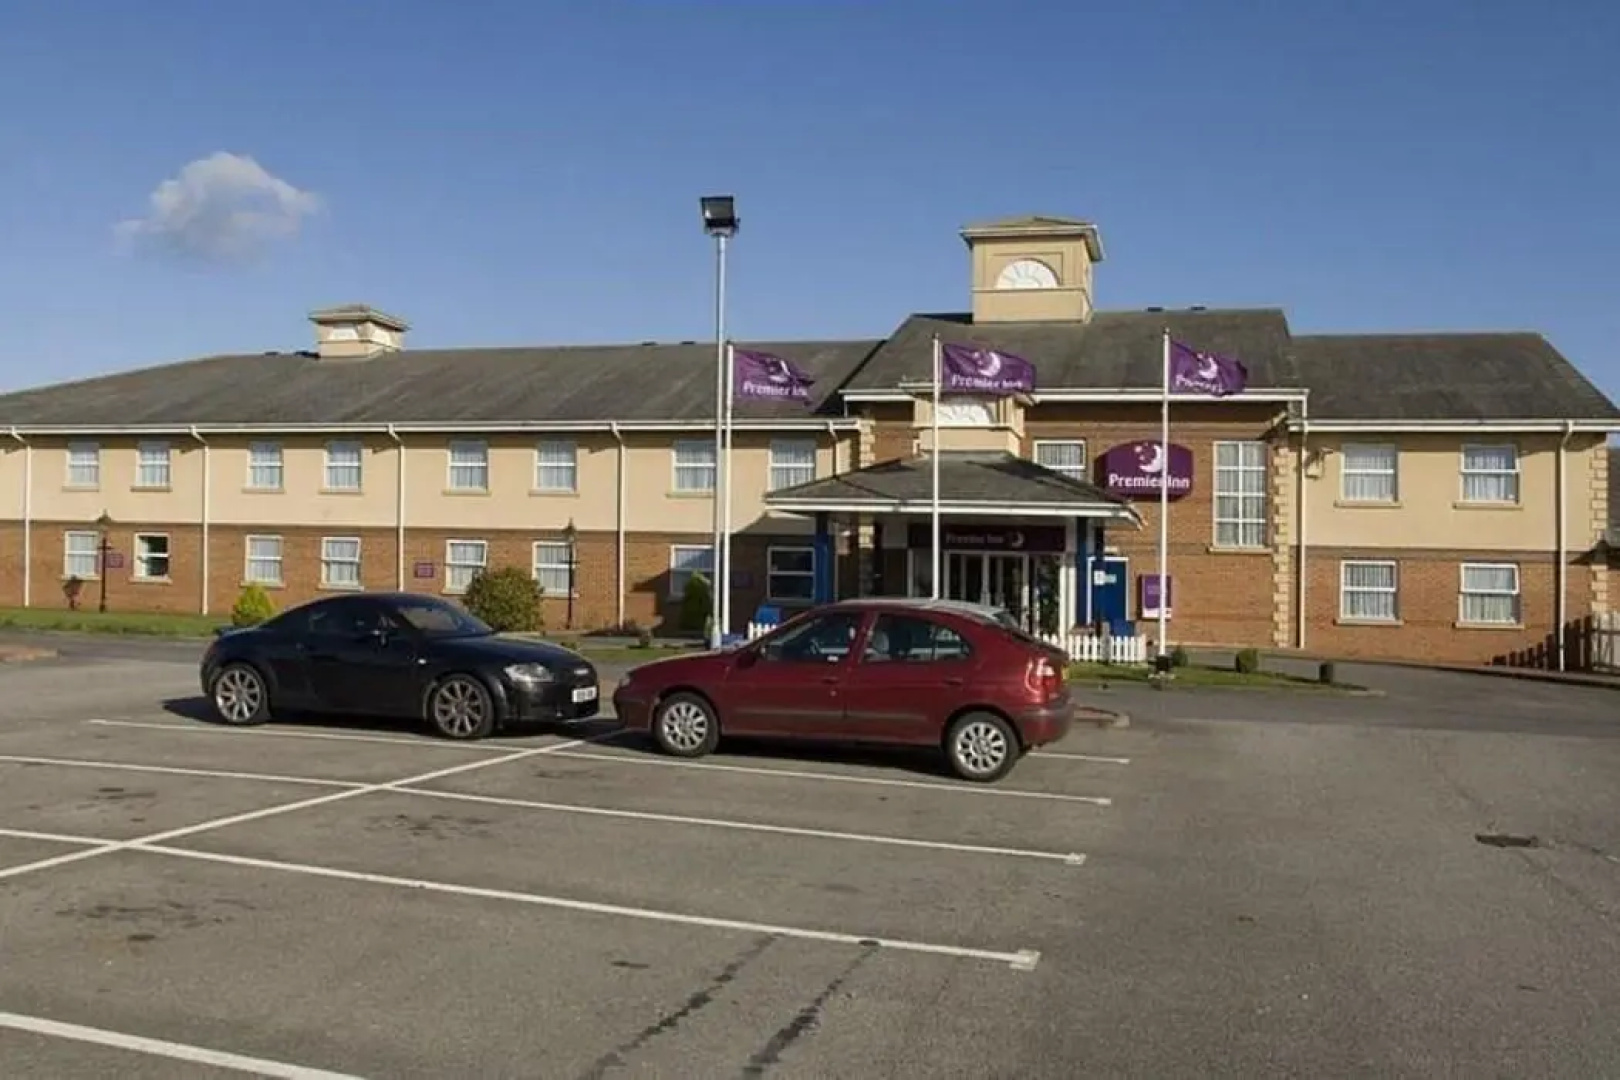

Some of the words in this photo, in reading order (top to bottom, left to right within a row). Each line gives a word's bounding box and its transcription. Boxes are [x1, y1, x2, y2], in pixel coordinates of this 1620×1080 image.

[743, 381, 790, 396] Premier
[951, 374, 1000, 389] Premier
[1108, 473, 1165, 487] Premie
[1167, 475, 1190, 489] Inn
